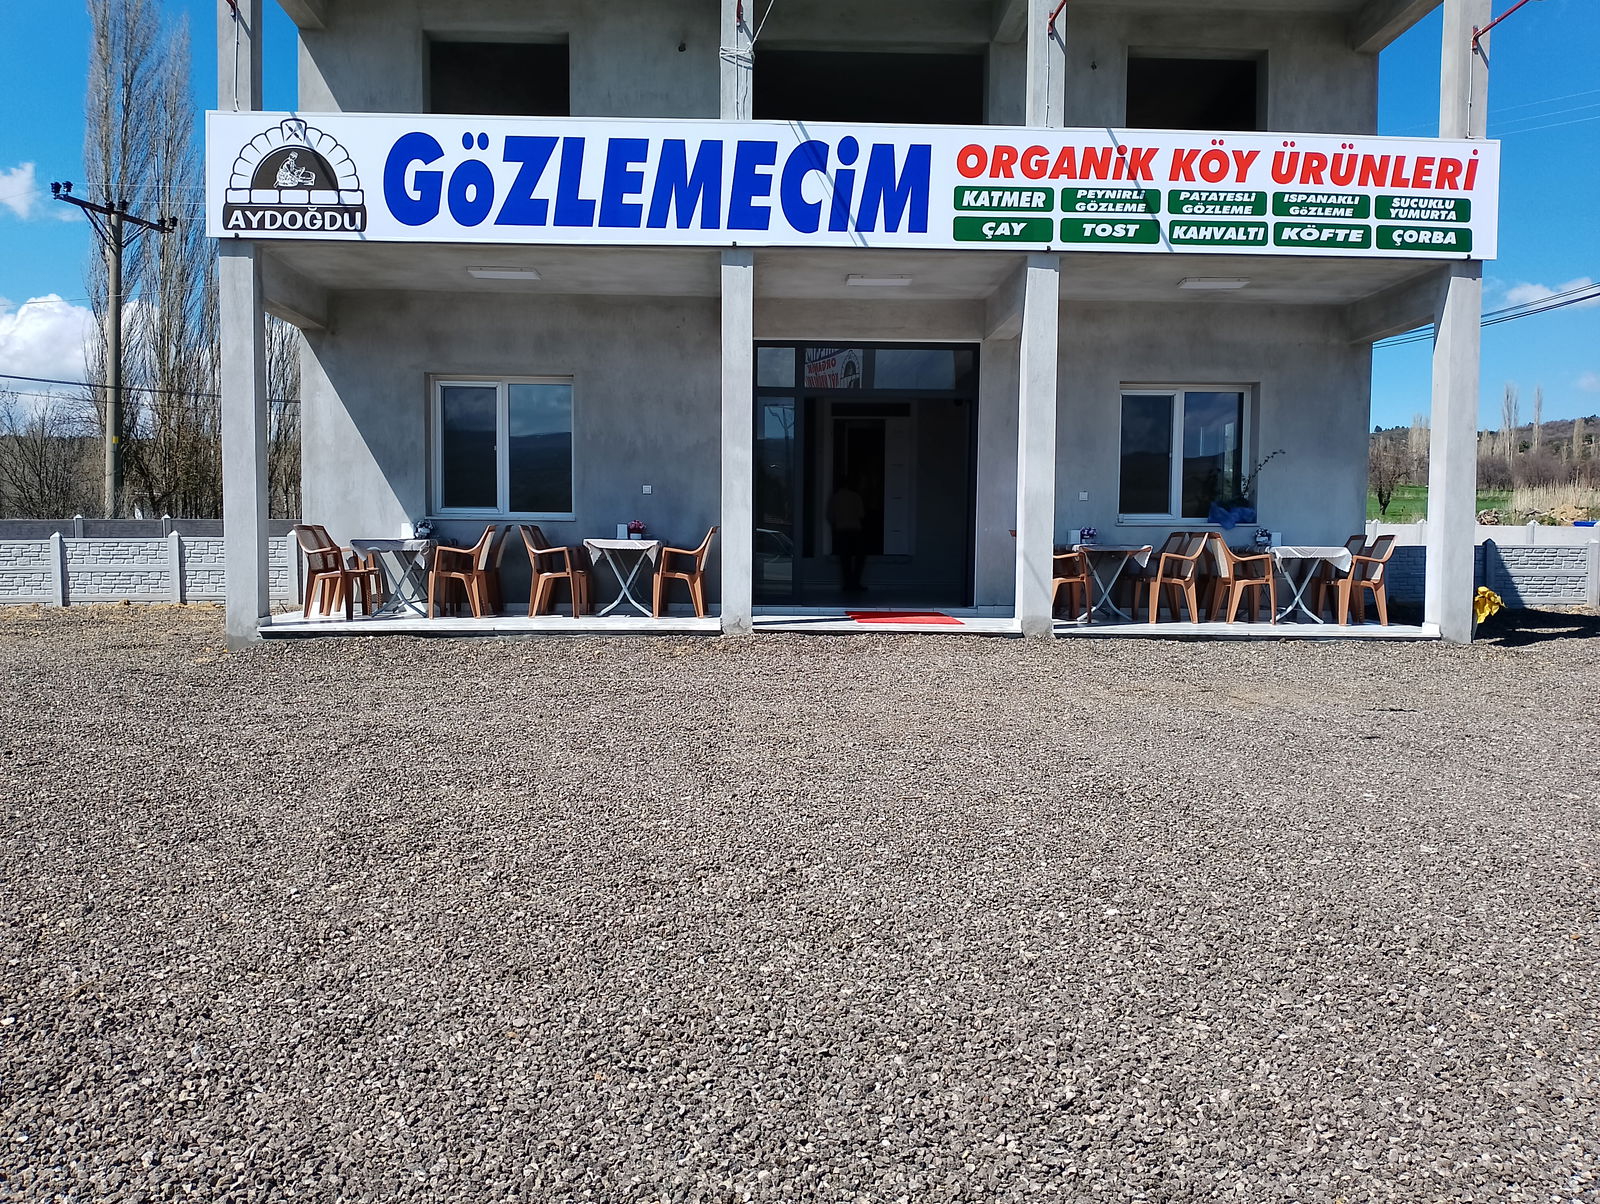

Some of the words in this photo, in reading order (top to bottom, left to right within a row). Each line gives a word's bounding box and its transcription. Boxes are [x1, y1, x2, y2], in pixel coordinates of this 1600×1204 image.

[1169, 139, 1261, 184] KÖY
[1271, 141, 1479, 191] ÜRÜNLERİ
[962, 190, 1048, 208] KATMER
[1075, 200, 1147, 213] GÖZLEME
[1283, 193, 1360, 206] ISPANAKLI
[1391, 198, 1456, 210] SUCUKLU
[1182, 203, 1253, 215] GÖZLEME
[1389, 208, 1457, 221] YUMURTA
[227, 206, 362, 231] AYDOĞDU
[981, 222, 1028, 239] ÇAY
[1082, 223, 1140, 238] TOST
[1172, 225, 1265, 242] KAHVALTI
[1281, 224, 1365, 243] KÖFTE
[1391, 229, 1457, 247] ÇORBA
